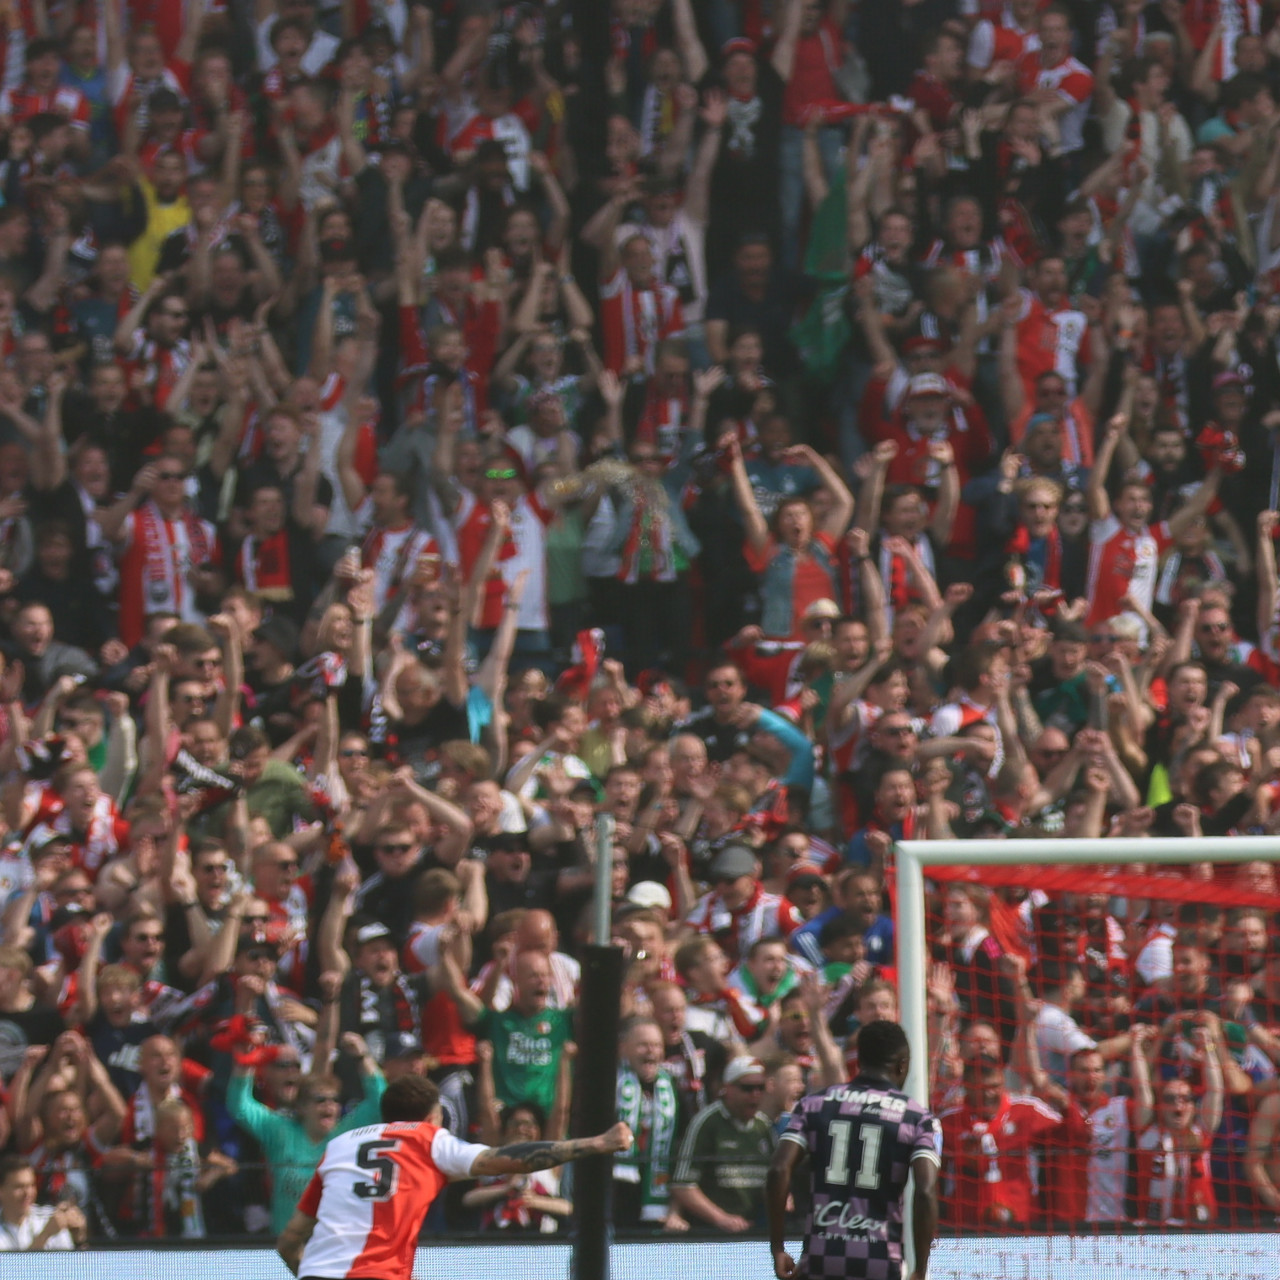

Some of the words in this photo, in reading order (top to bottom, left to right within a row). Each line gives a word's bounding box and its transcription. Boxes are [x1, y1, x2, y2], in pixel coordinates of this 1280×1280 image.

[824, 1088, 907, 1113] JUMPER
[353, 1139, 400, 1200] 5
[825, 1120, 884, 1190] 11
